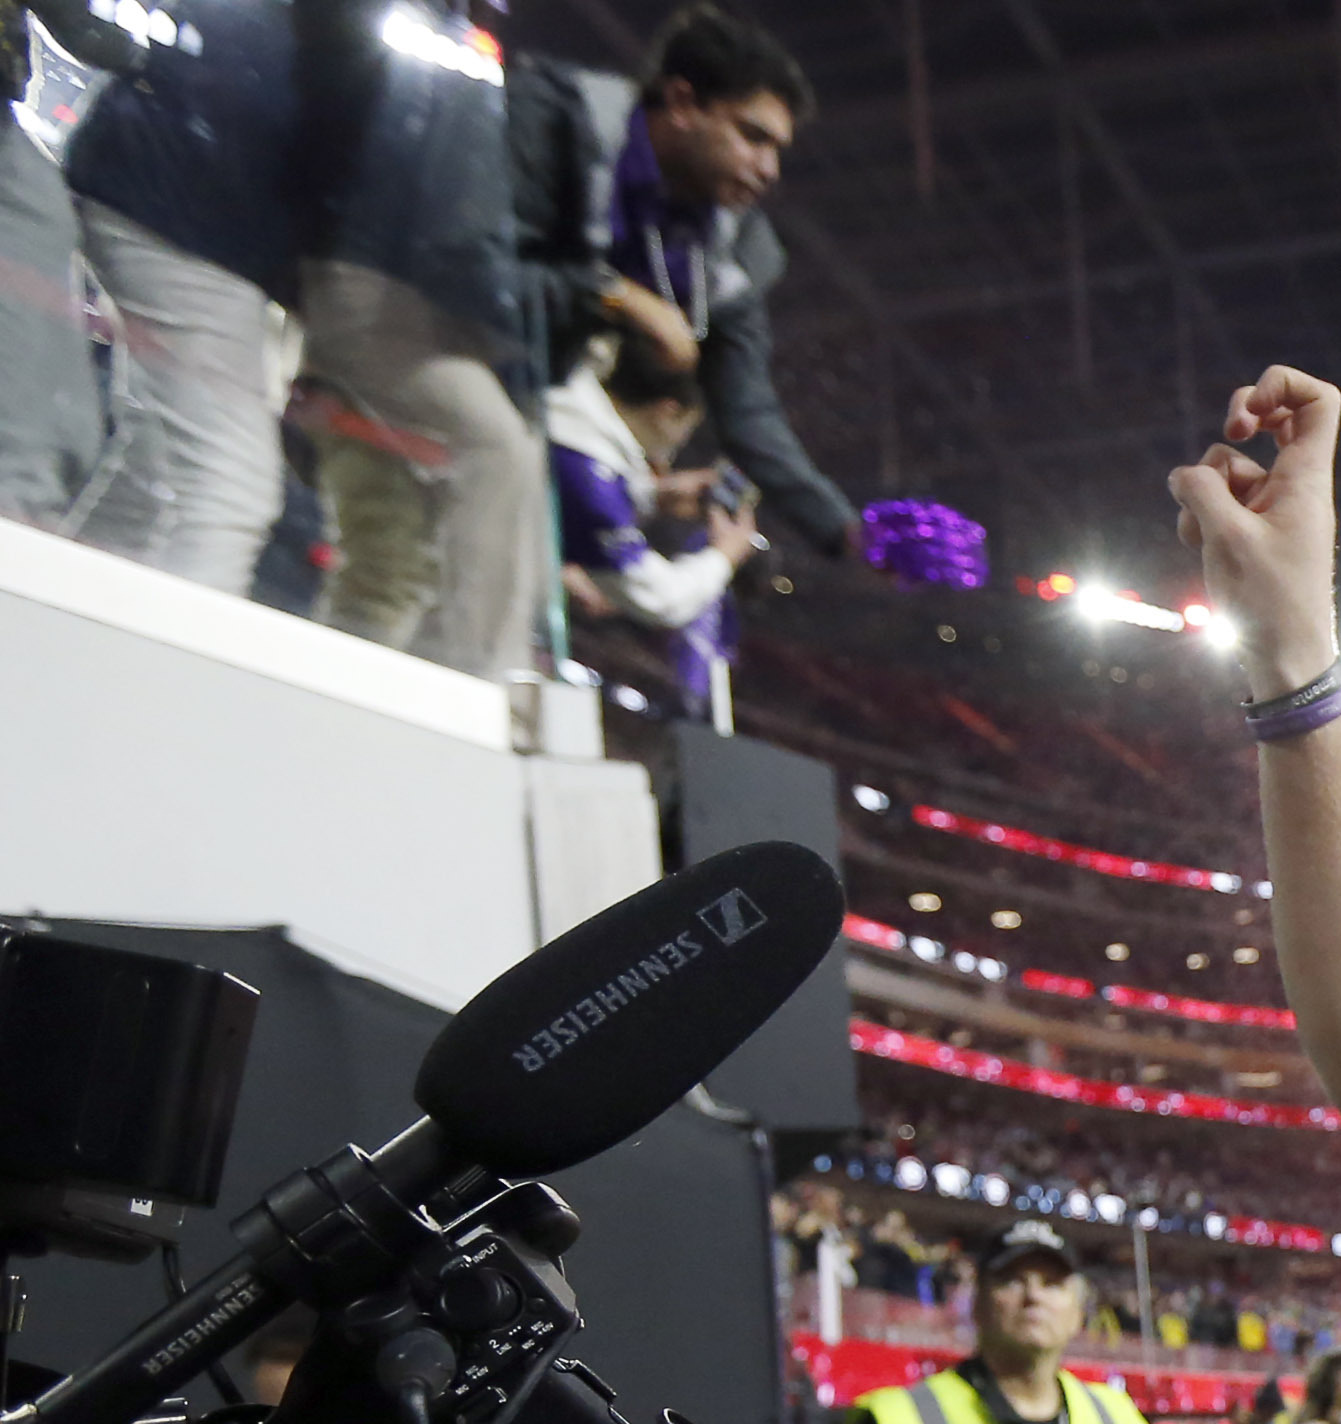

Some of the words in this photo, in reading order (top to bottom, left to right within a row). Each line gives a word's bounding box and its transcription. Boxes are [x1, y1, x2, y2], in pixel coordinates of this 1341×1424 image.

[512, 928, 704, 1074] SENNHEISER
[473, 1242, 498, 1263] INPUT
[141, 1284, 263, 1375] SENNHEISER
